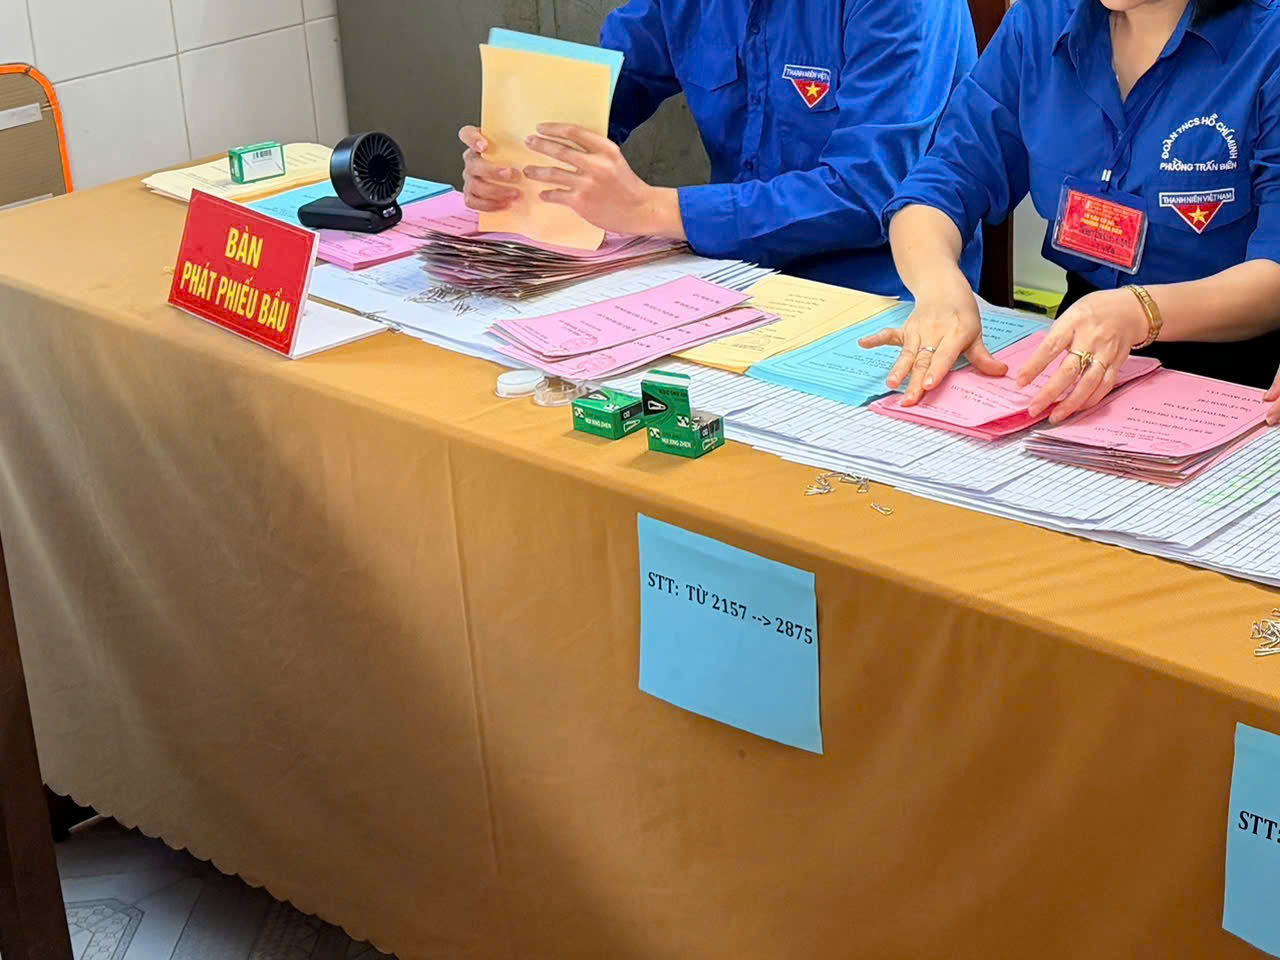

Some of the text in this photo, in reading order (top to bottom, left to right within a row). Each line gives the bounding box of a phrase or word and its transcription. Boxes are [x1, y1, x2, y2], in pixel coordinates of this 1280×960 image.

[225, 225, 264, 269] BÀN
[180, 260, 291, 333] PHÁT PHIẾU BẦU
[648, 571, 679, 596] STT:
[685, 584, 708, 605] TỪ
[711, 593, 747, 620] 2157
[775, 617, 813, 645] 2875
